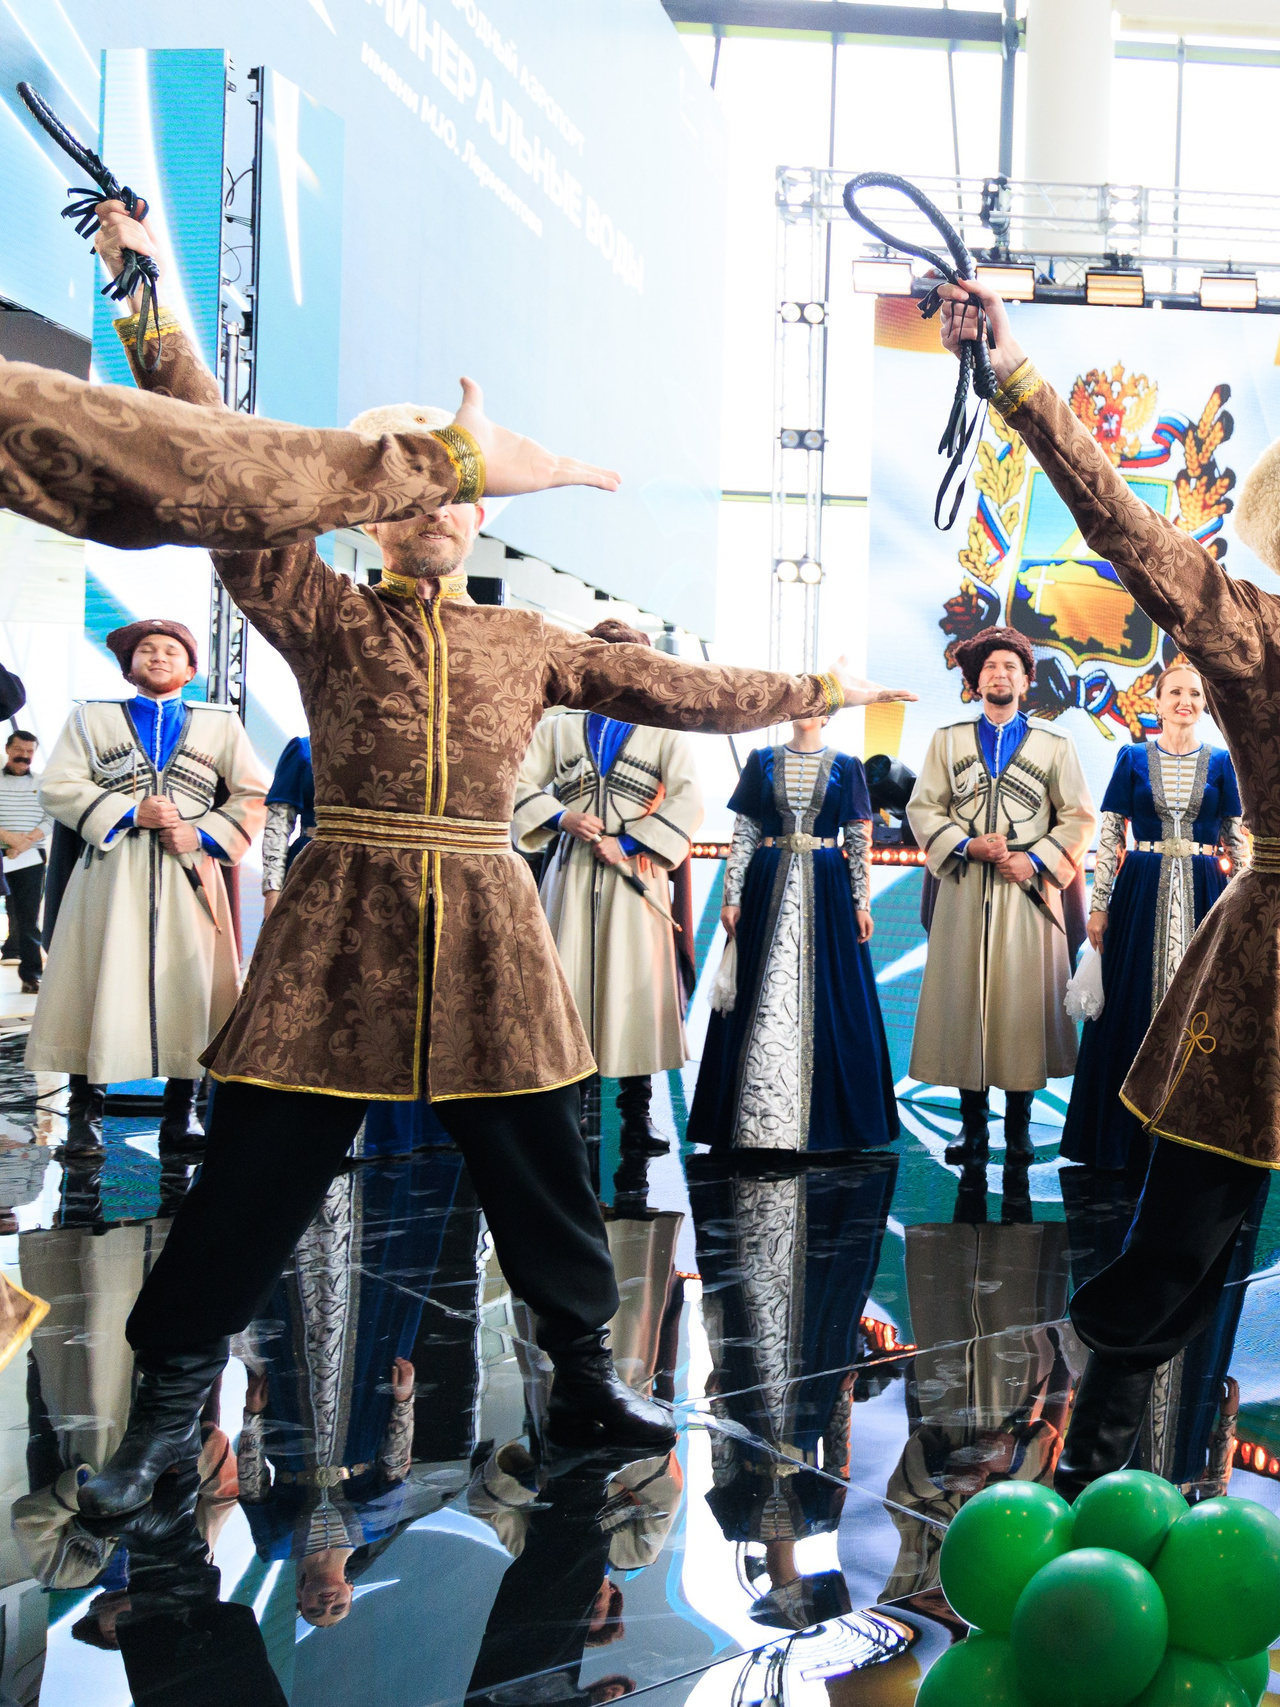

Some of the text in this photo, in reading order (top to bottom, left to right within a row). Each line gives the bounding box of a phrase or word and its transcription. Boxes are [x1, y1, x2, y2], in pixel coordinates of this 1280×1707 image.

[361, 41, 419, 114] имени
[461, 139, 543, 237] Лермонтова
[519, 64, 585, 156] АЭРОПОРТ
[585, 195, 644, 294] ВОДЫ
